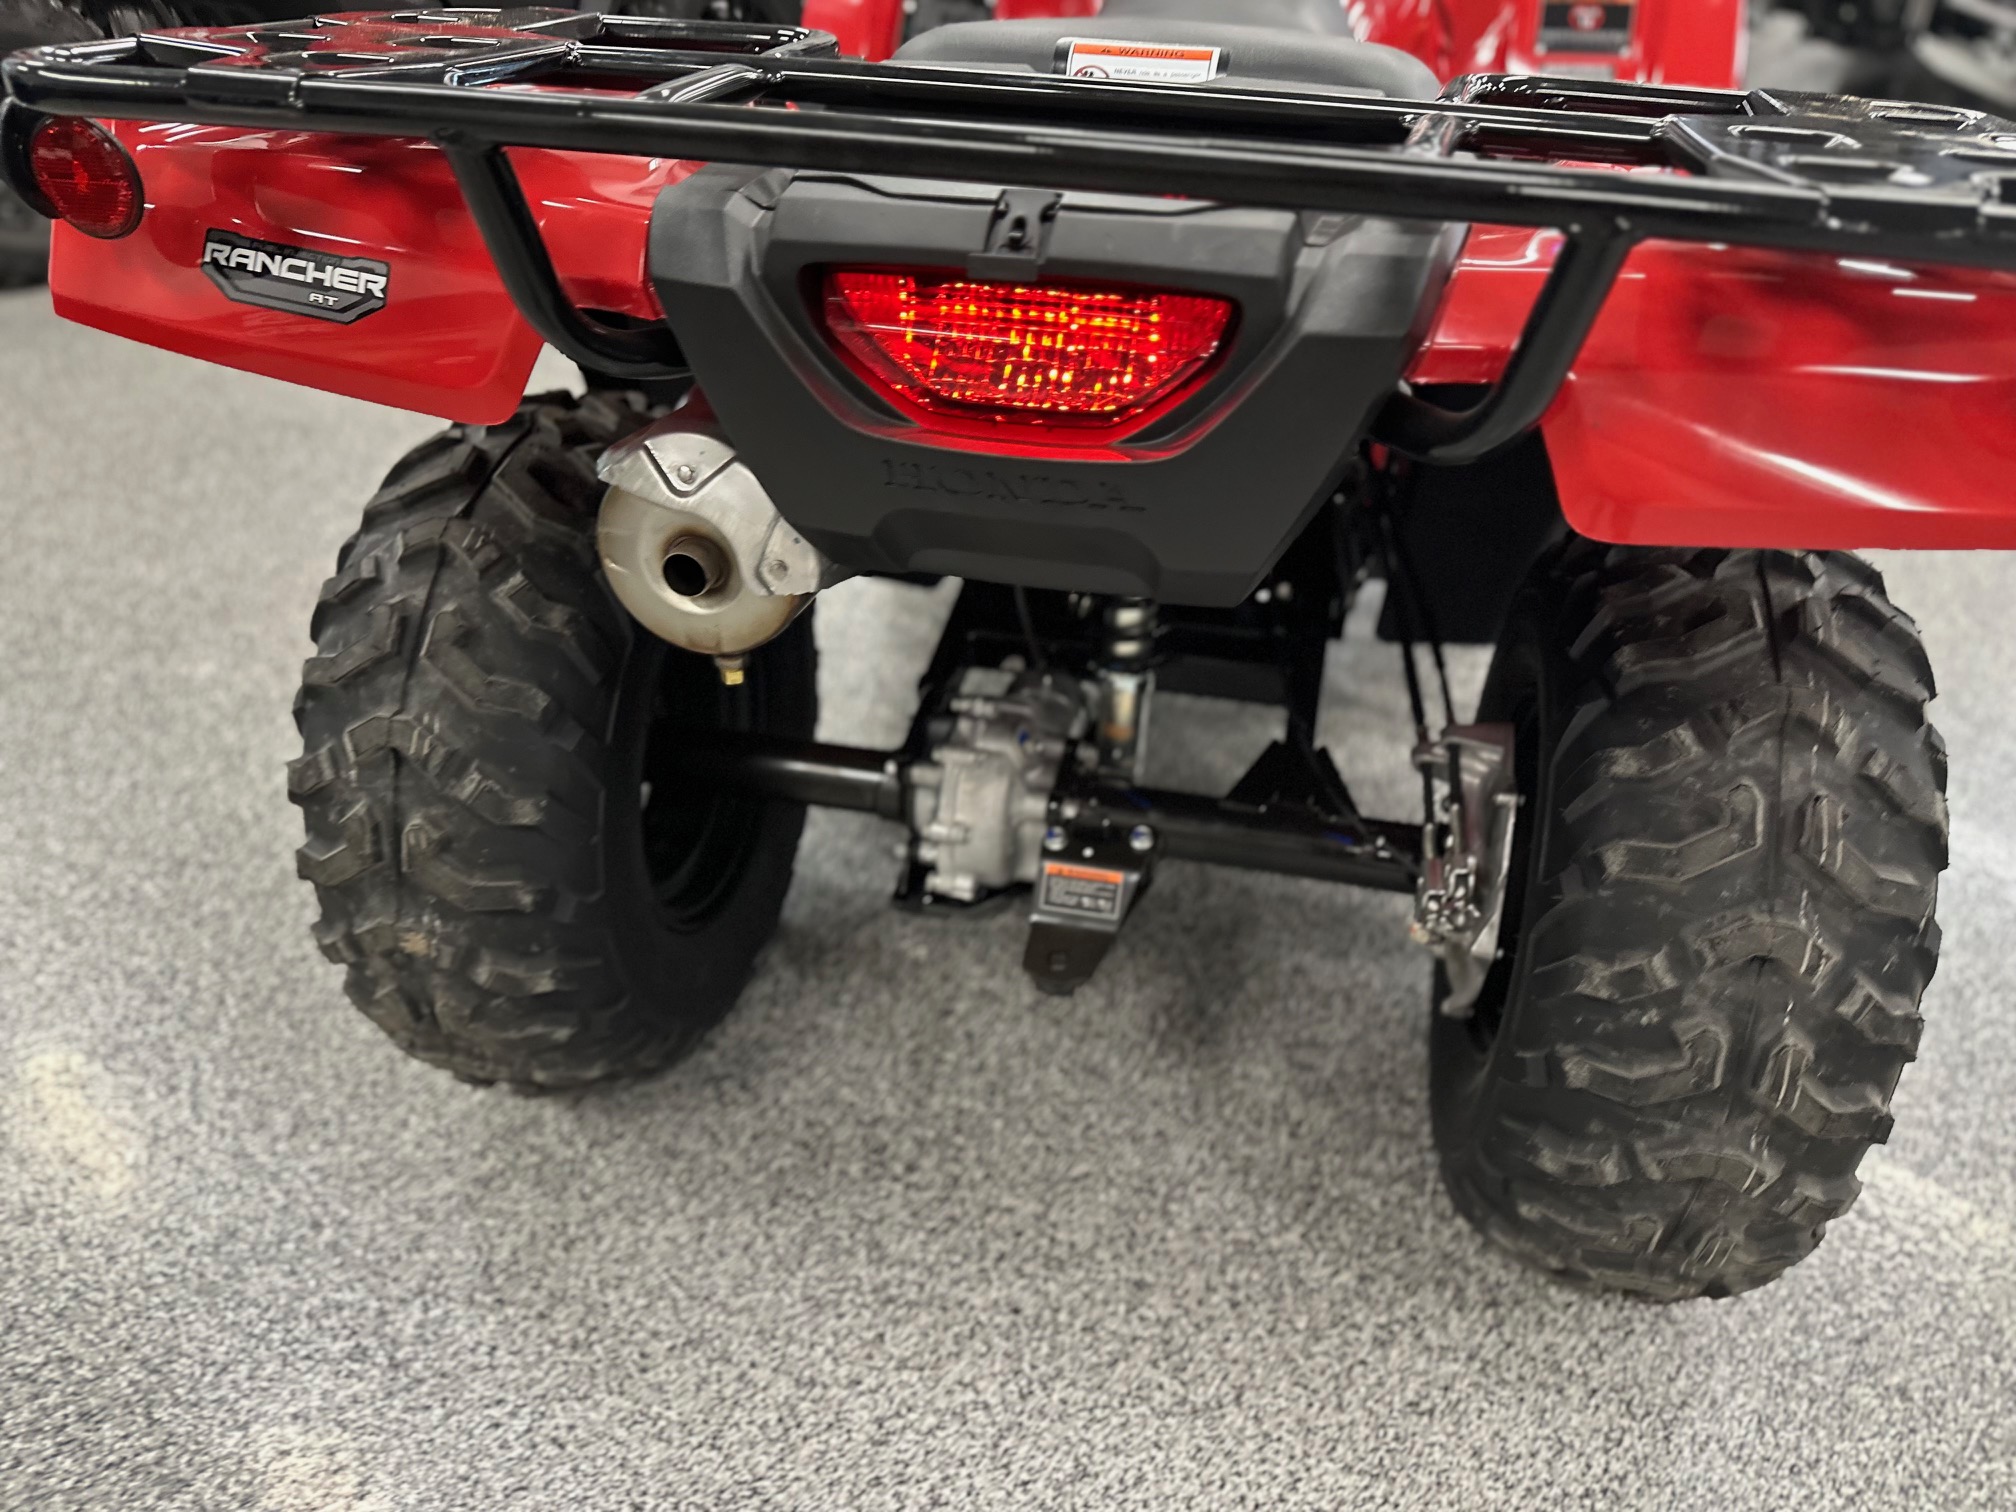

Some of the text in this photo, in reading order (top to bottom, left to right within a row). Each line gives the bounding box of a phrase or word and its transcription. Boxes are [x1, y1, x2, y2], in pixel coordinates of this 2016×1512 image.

[1120, 47, 1185, 57] WARNING
[203, 241, 387, 298] RANCHER
[309, 292, 338, 306] AT
[881, 458, 1146, 511] HONDA
